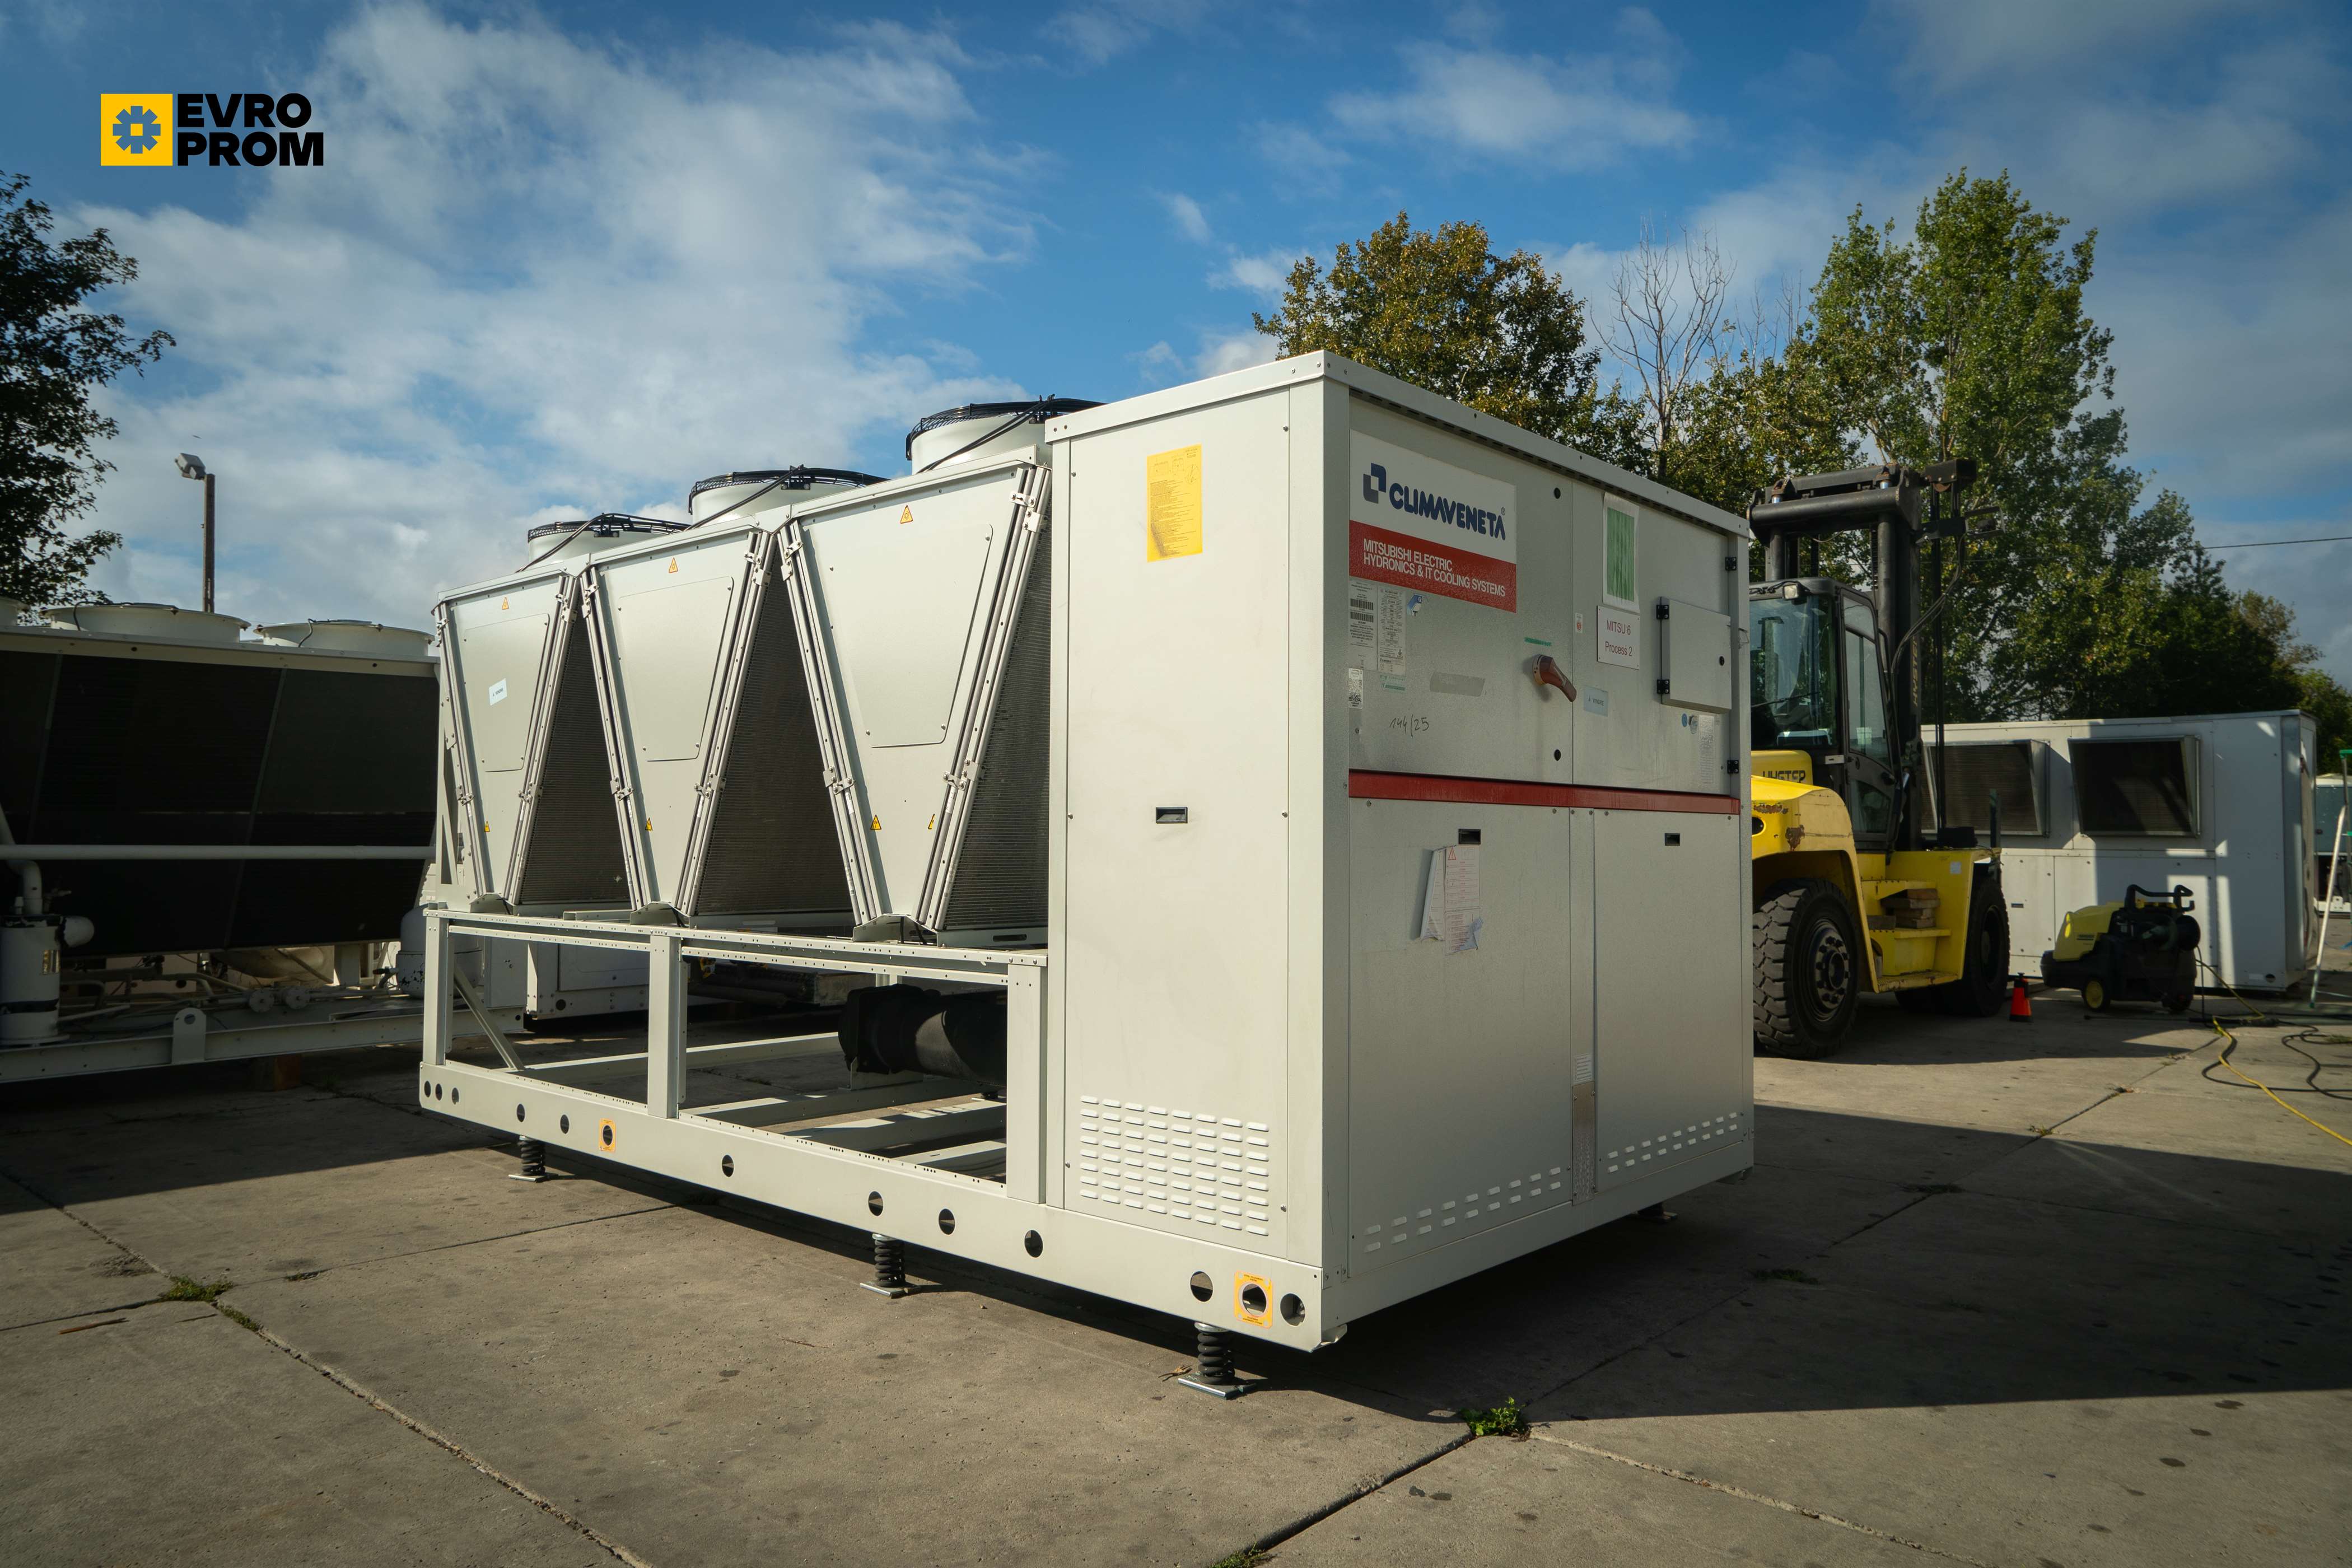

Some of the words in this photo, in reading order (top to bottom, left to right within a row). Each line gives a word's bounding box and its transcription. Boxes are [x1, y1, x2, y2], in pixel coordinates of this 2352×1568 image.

[1389, 483, 1506, 540] CLIMAVENETA
[1364, 538, 1411, 562] MITSUBISHI
[1413, 550, 1453, 572] ELECTRIC
[1364, 553, 1415, 576] HYDRONICS
[1417, 566, 1424, 577] &
[1425, 567, 1434, 580] IT
[1434, 569, 1471, 588] COOLING
[1472, 578, 1505, 597] SYSTEMS
[1606, 619, 1626, 634] MITSU
[1627, 625, 1631, 636] 6
[1605, 641, 1627, 656] Process
[1628, 646, 1632, 657] 2
